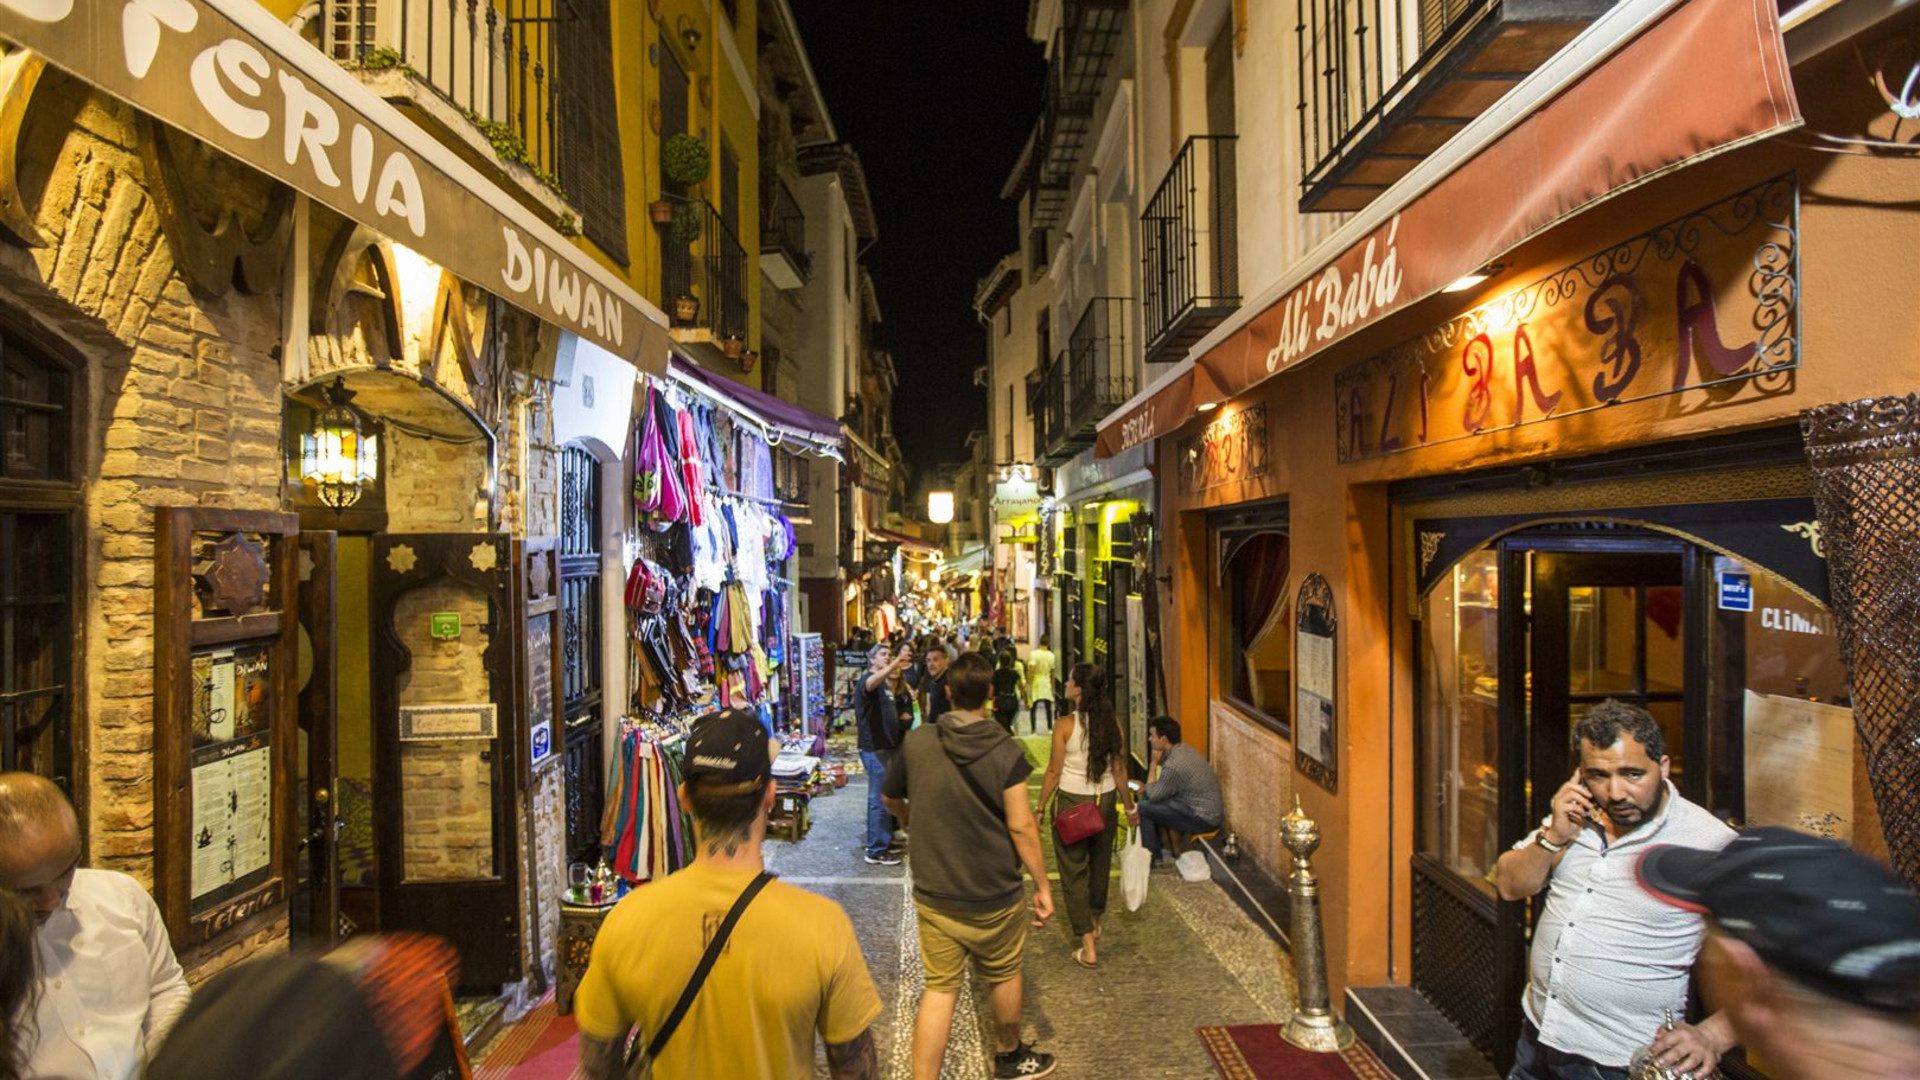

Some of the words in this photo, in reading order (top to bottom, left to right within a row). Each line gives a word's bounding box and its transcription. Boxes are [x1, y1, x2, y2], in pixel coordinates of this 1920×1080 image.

[0, 0, 426, 238] TERIA
[501, 226, 623, 346] DIWAN
[1315, 213, 1403, 342] Babá
[1461, 258, 1757, 434] BABA
